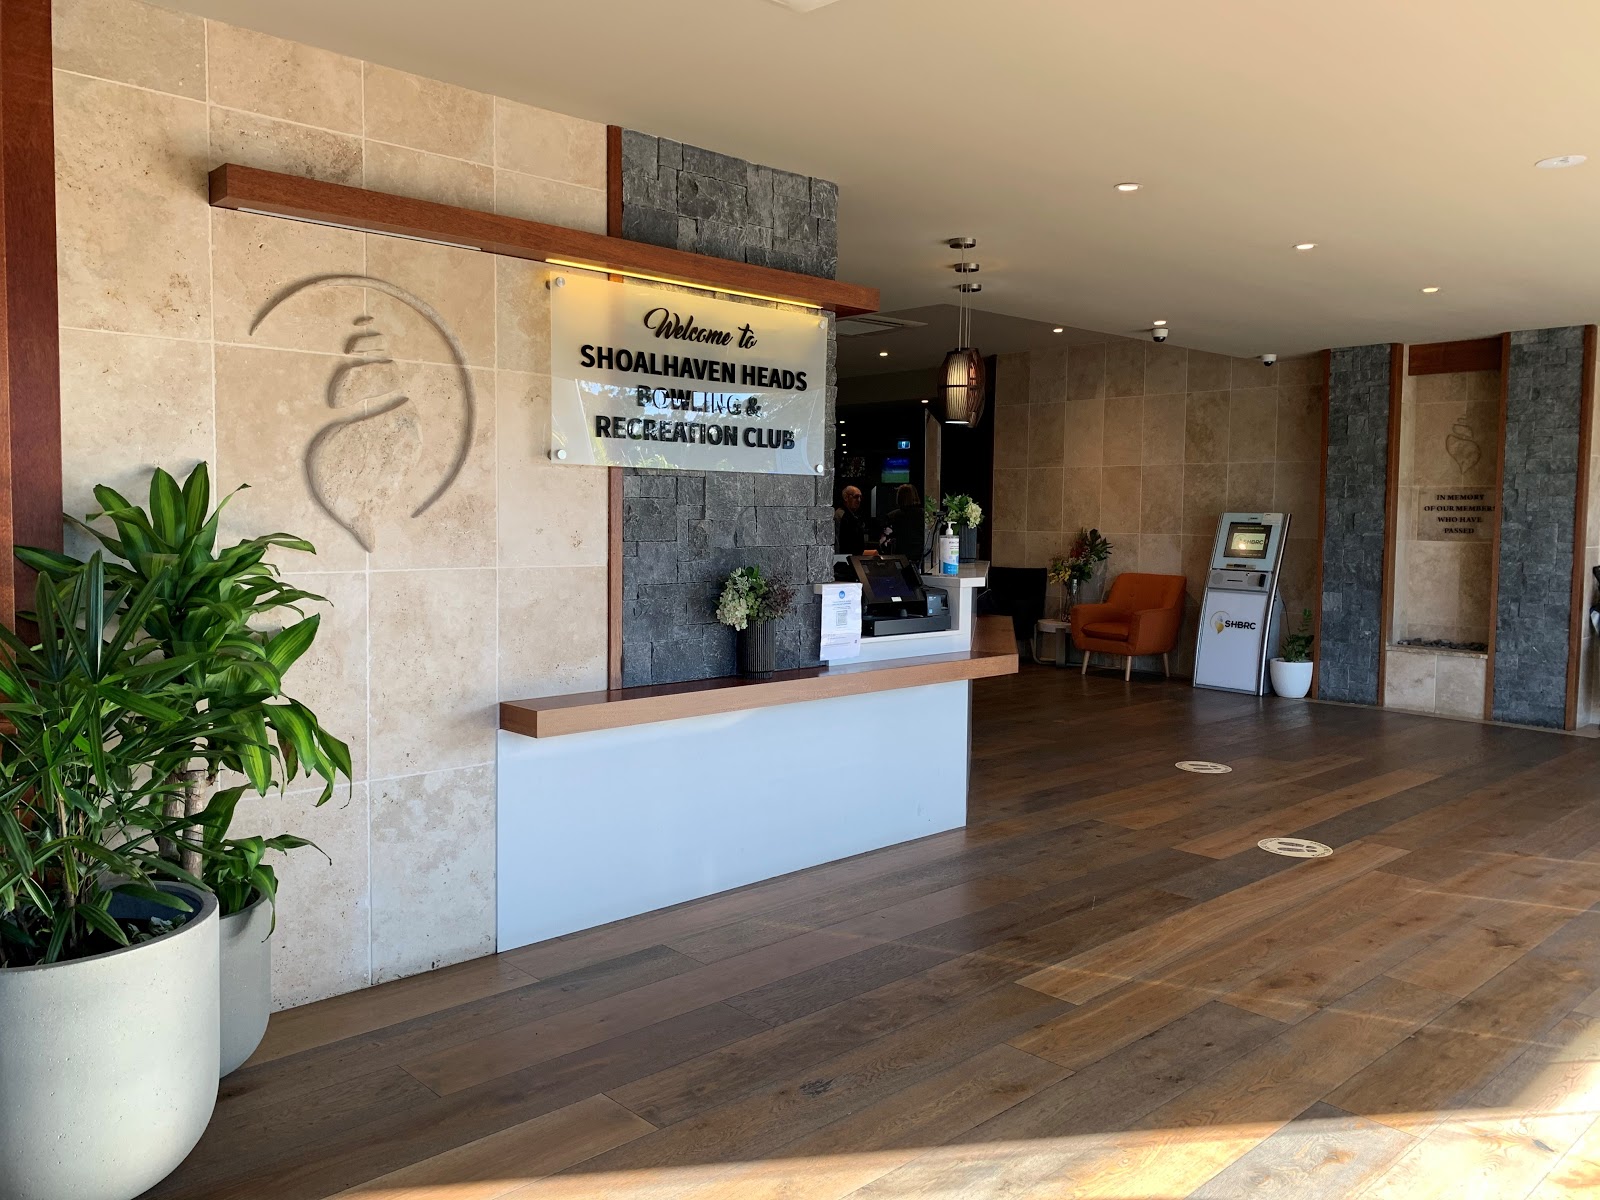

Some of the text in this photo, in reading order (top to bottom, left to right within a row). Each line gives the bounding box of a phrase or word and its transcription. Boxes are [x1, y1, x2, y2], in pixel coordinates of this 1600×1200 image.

[643, 307, 758, 349] Welcome to
[580, 344, 808, 391] SHOALHAVEN HEADS
[636, 384, 761, 417] BOWLING &
[595, 415, 795, 450] RECREATION CLUB
[1224, 620, 1256, 630] SHBRC
